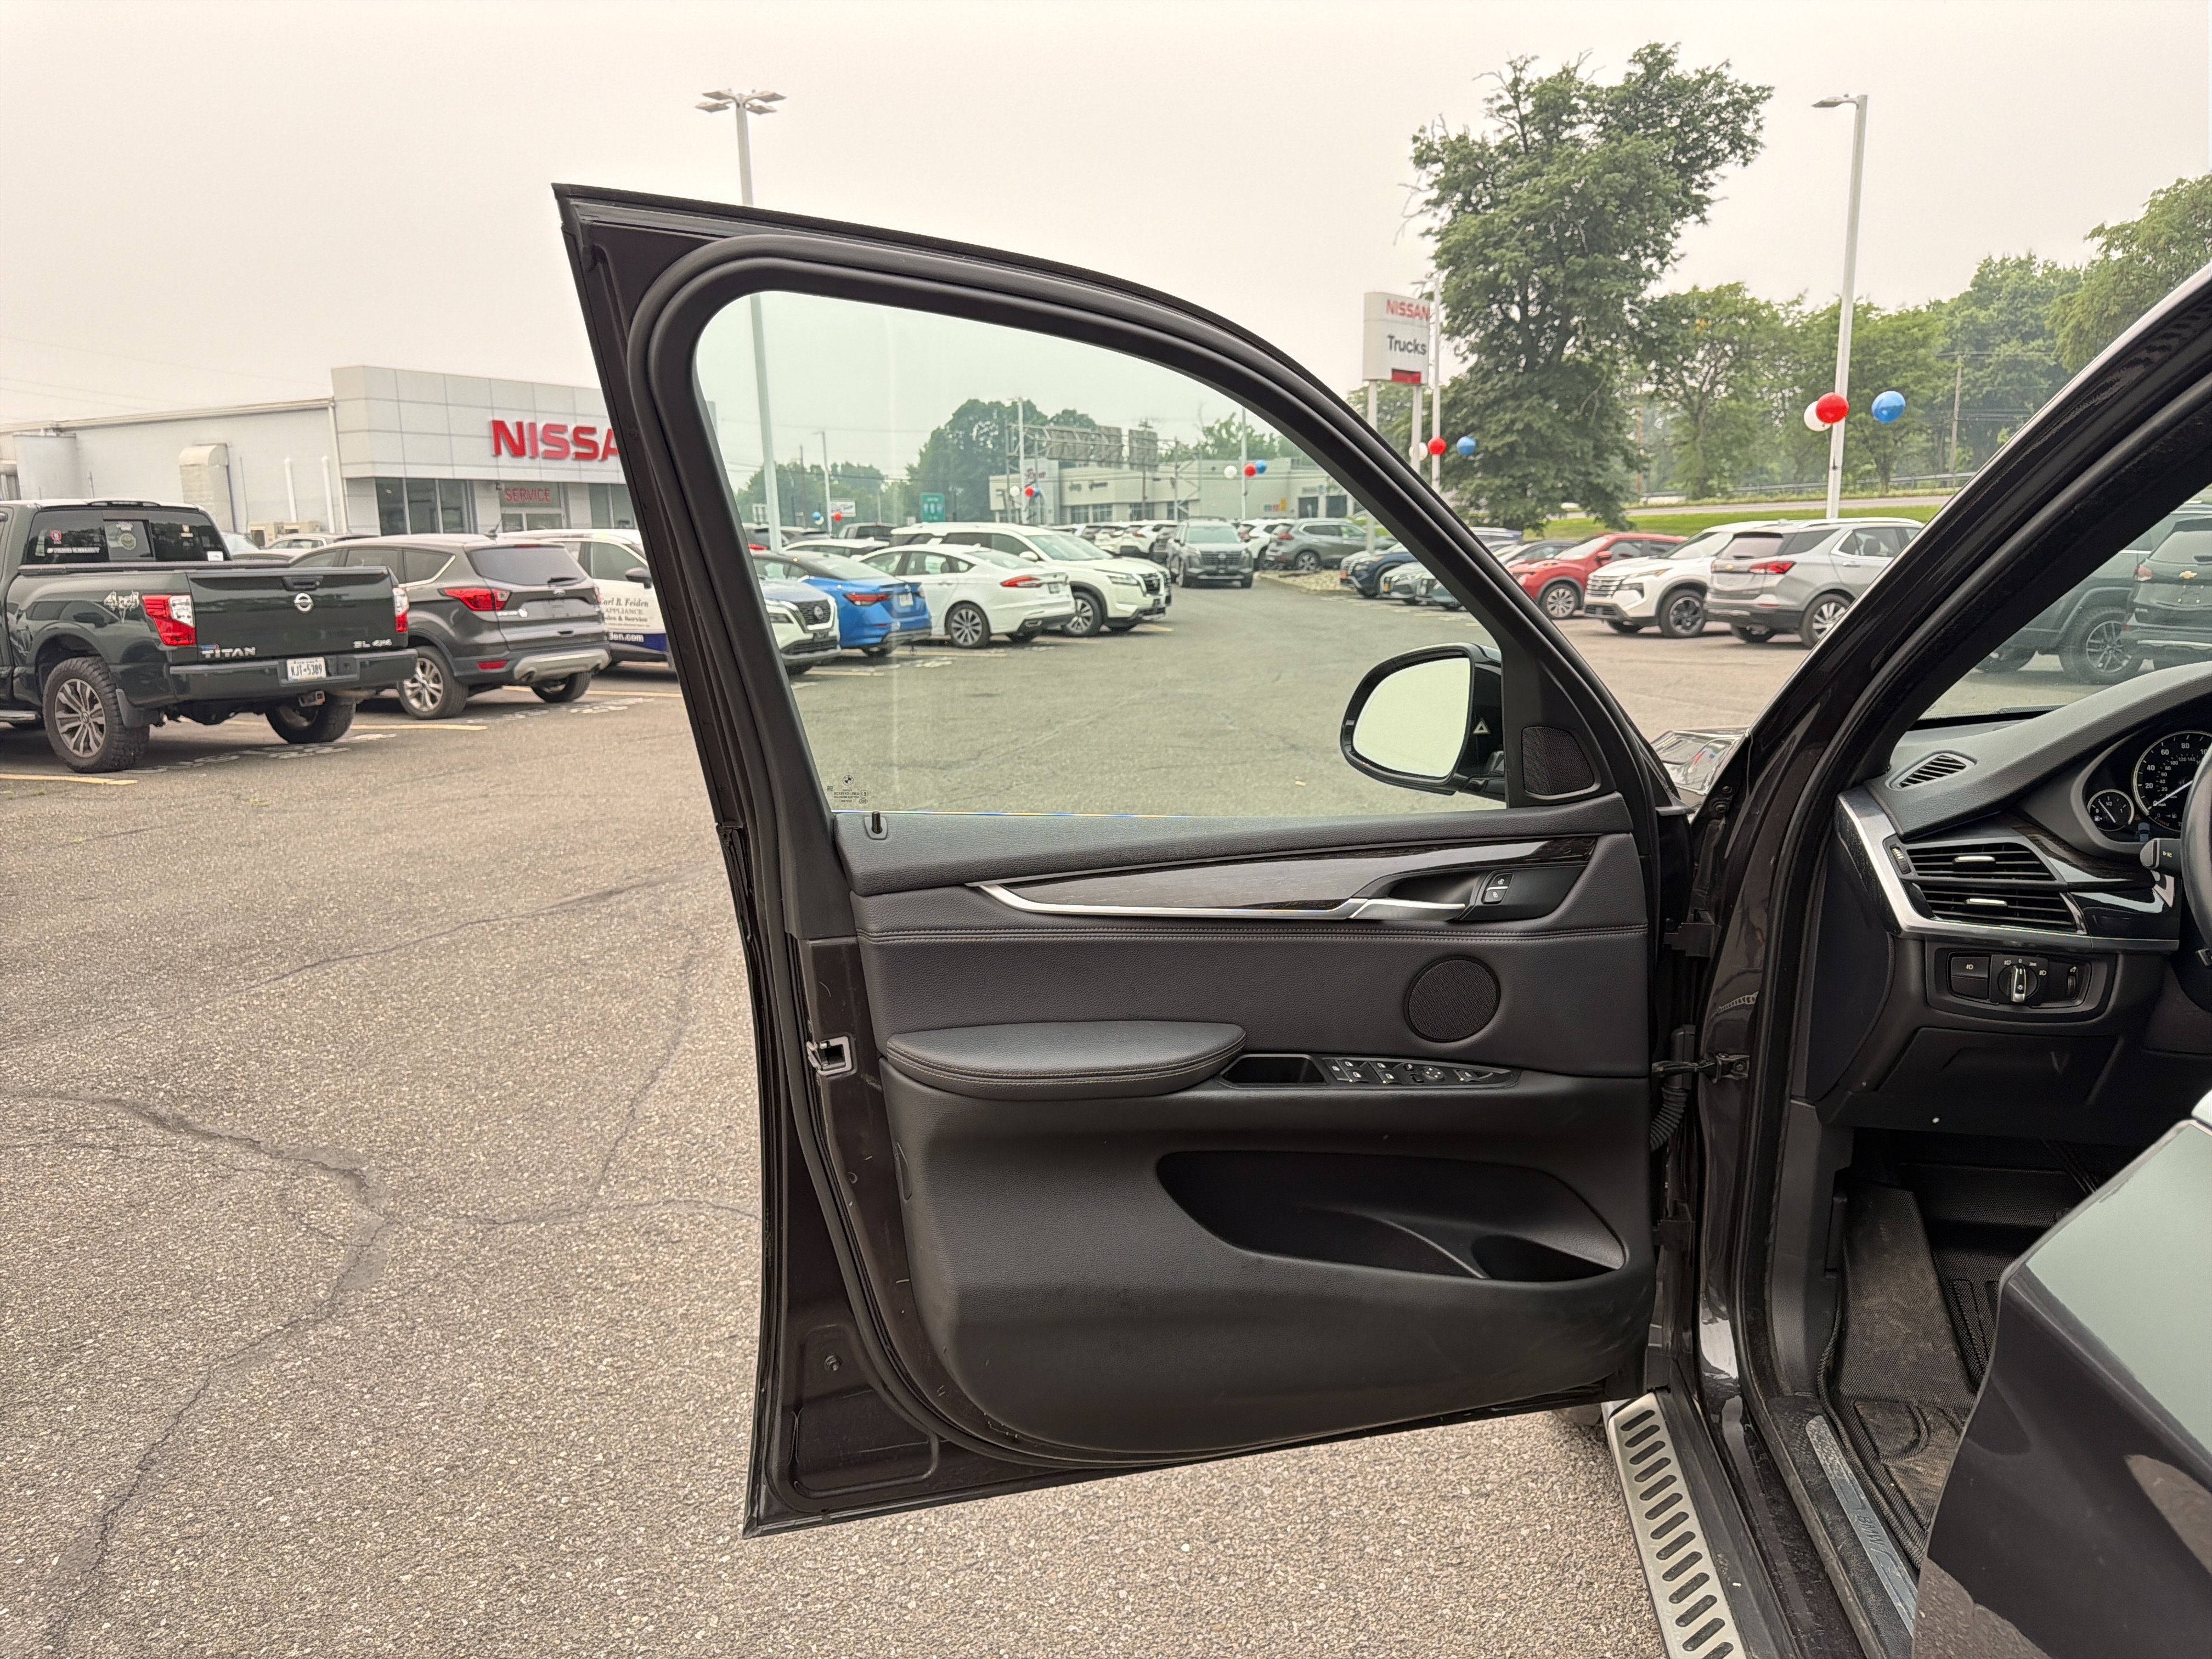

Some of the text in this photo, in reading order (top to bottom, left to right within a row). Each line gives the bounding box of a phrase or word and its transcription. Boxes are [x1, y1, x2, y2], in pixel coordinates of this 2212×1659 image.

[1386, 299, 1430, 321] NISSAN
[1387, 335, 1427, 356] Trucks
[492, 419, 619, 461] NISSA
[505, 487, 551, 503] SERVICE
[201, 647, 256, 658] TITAN
[1856, 1515, 1886, 1546] BMW
